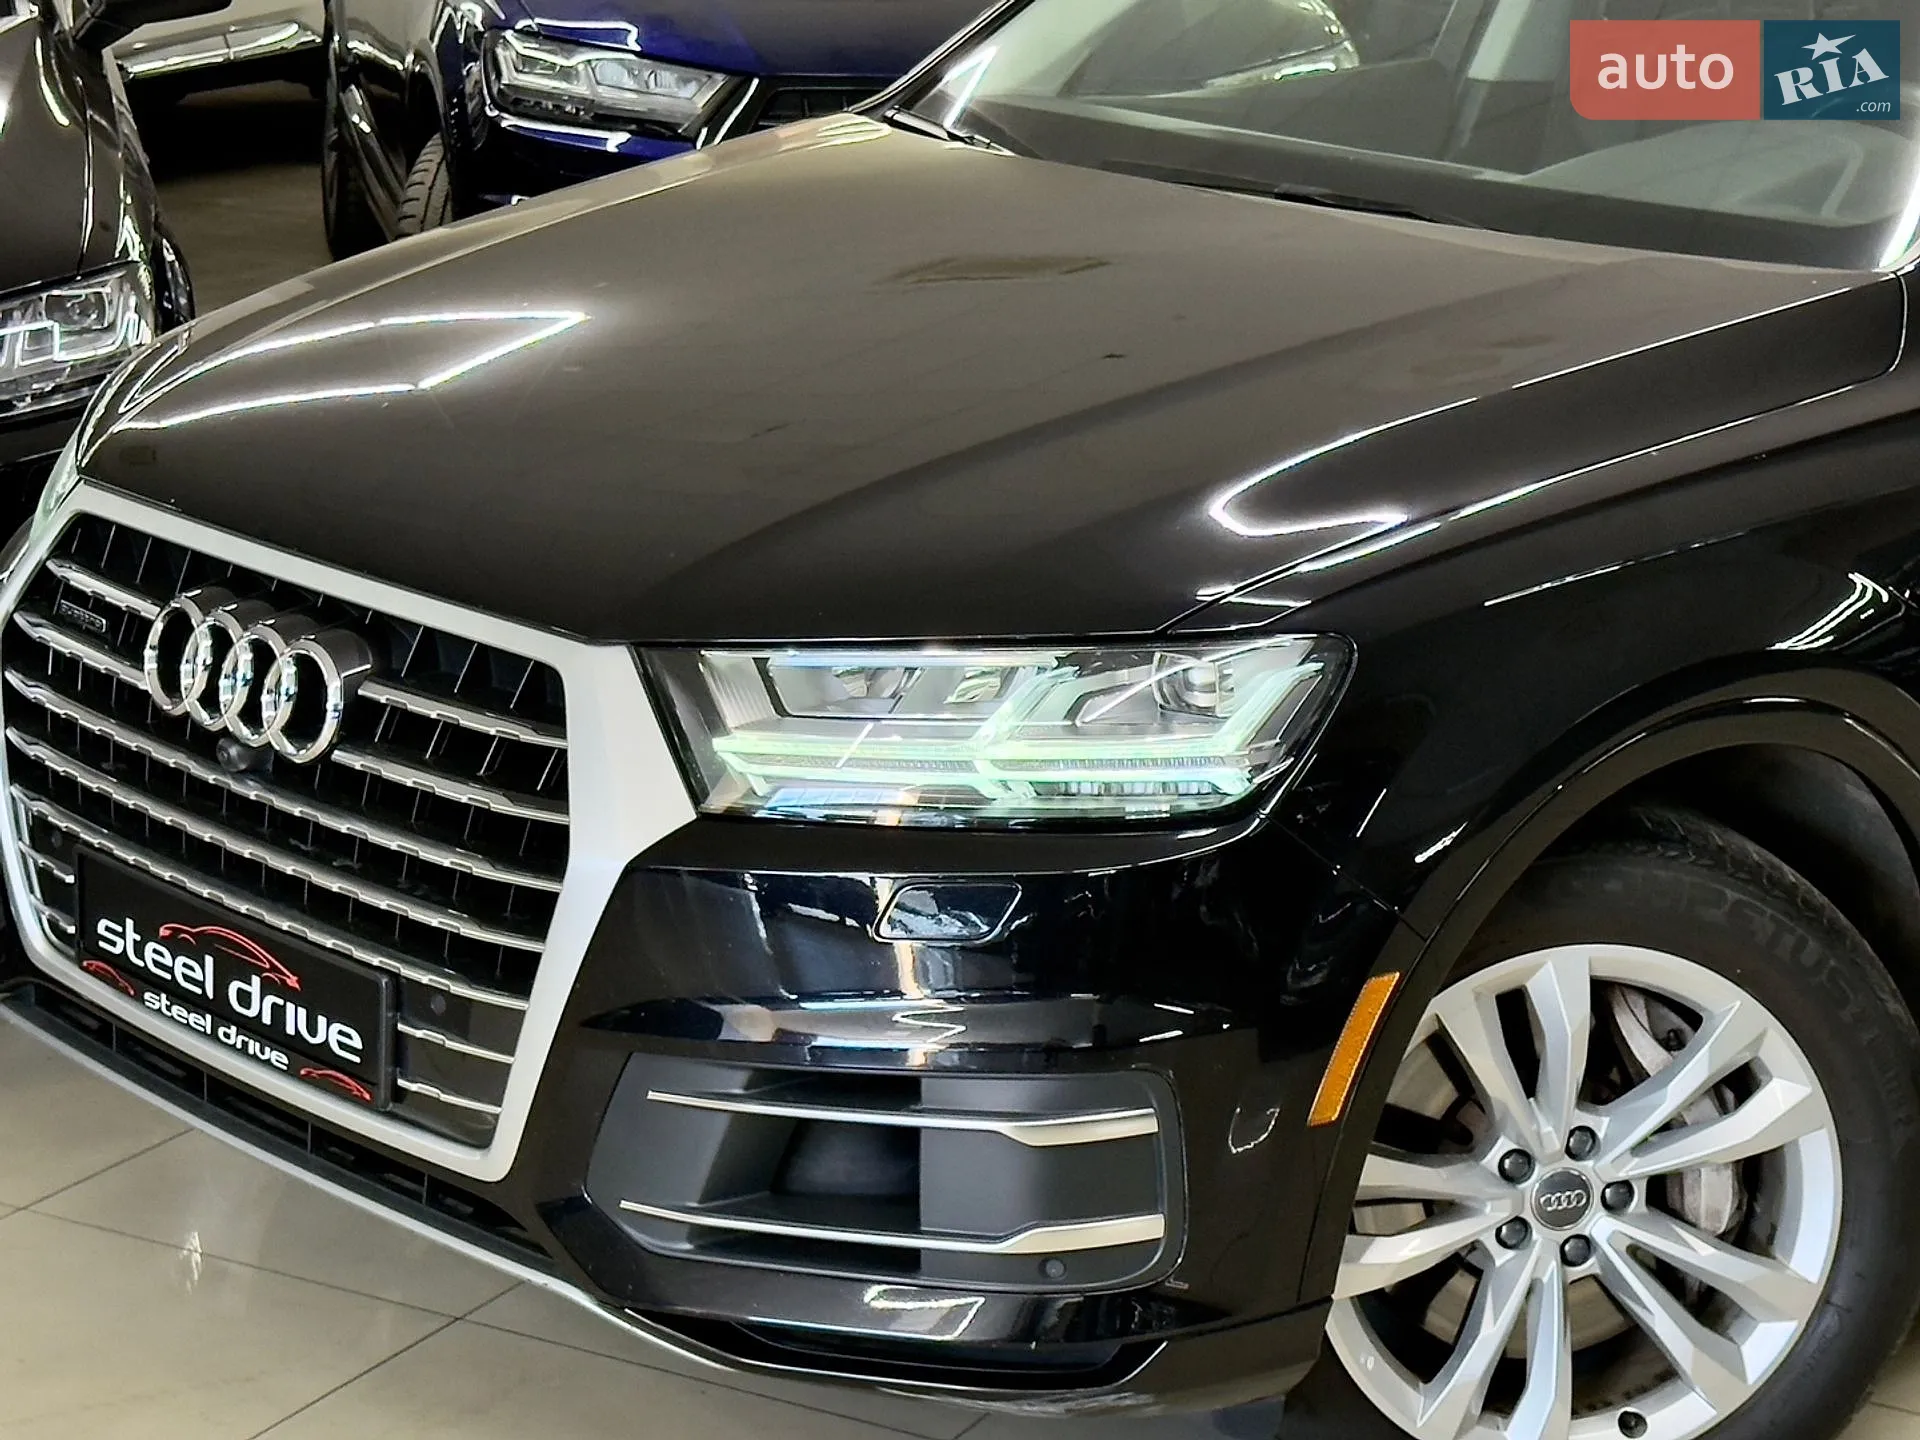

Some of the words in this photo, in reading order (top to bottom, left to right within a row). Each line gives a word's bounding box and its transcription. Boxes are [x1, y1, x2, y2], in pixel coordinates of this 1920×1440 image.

[97, 917, 214, 1000] steel
[227, 974, 363, 1064] drive
[143, 989, 212, 1035] steel
[217, 1025, 289, 1071] drive
